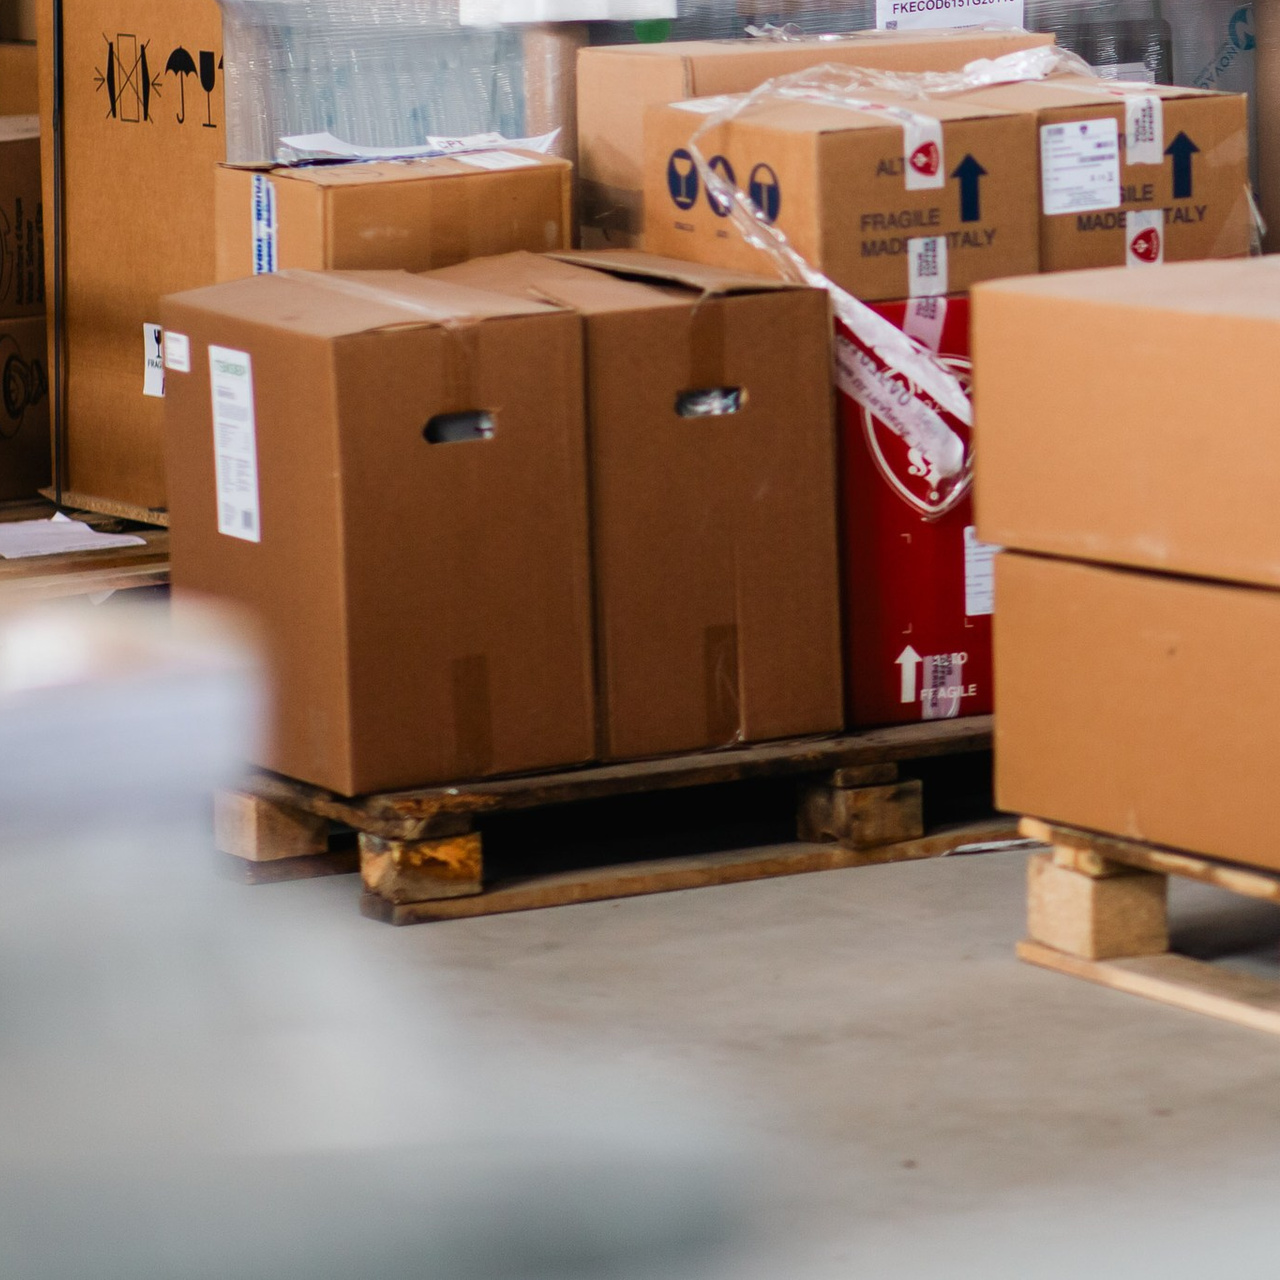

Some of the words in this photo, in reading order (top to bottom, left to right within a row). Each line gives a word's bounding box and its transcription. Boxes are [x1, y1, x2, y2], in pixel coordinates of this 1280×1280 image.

[1120, 183, 1154, 203] GILE
[860, 208, 940, 232] FRAGILE
[1076, 211, 1126, 232] MADE
[1163, 205, 1207, 224] TALY
